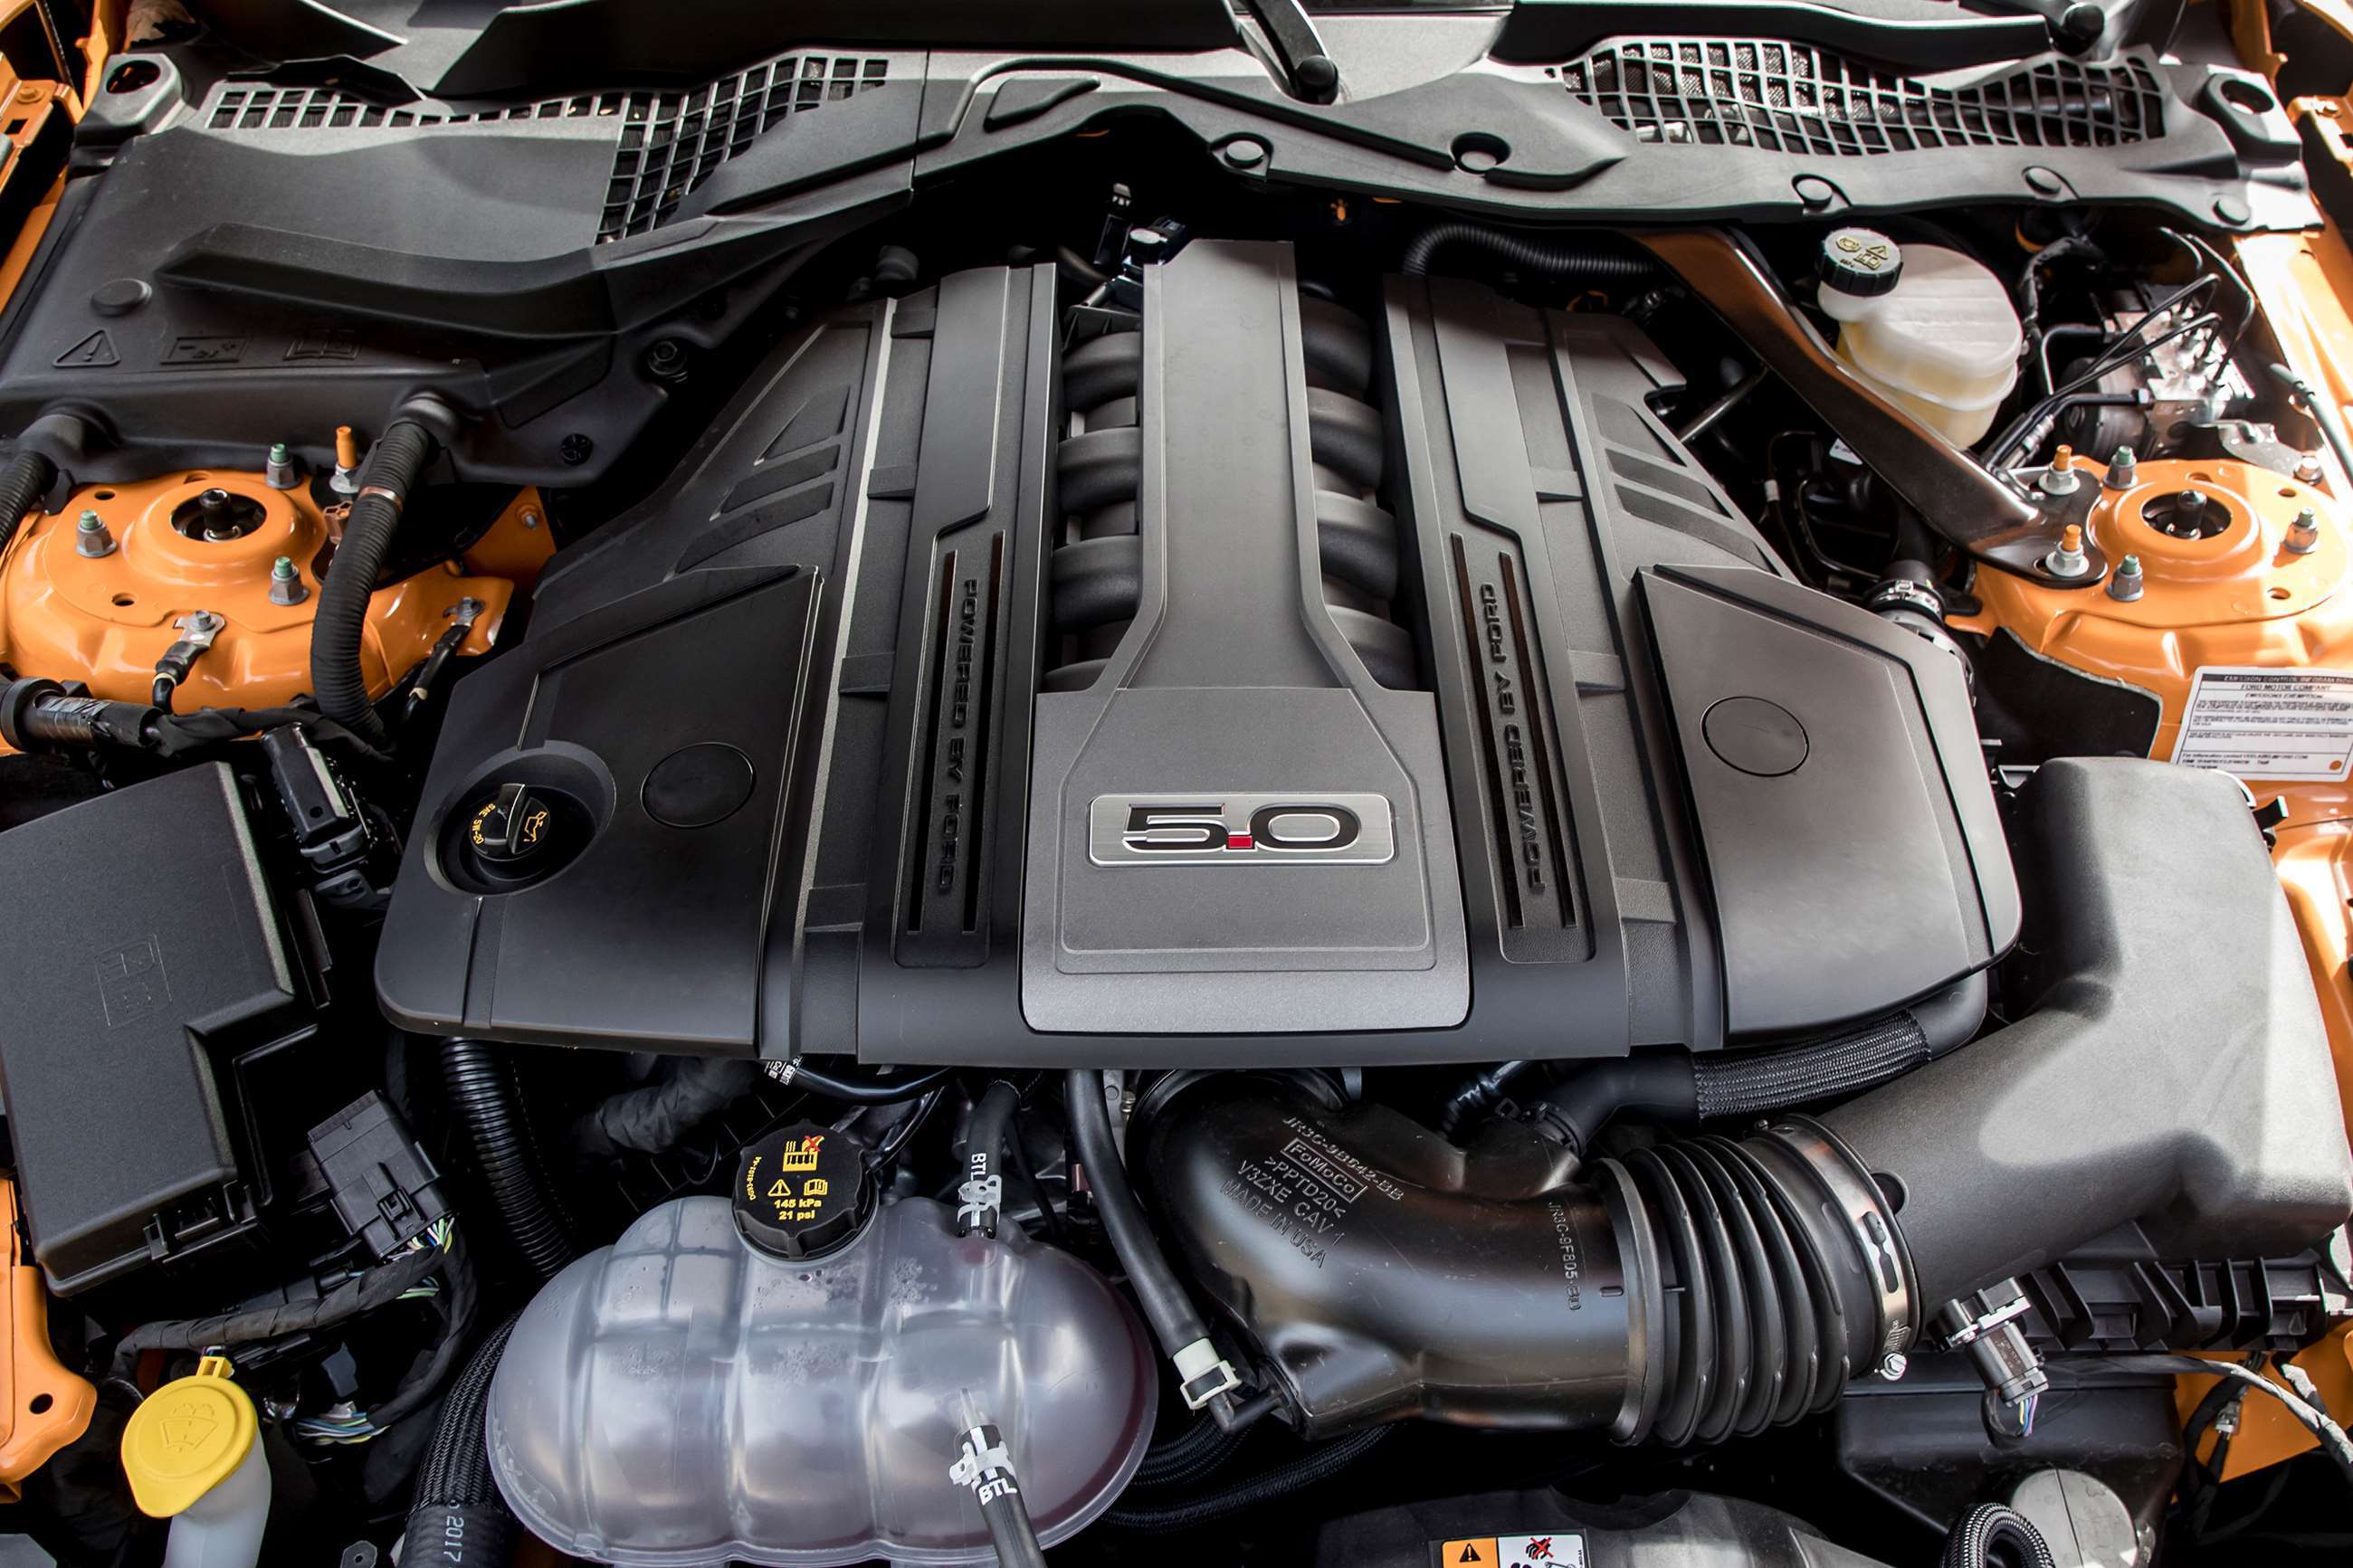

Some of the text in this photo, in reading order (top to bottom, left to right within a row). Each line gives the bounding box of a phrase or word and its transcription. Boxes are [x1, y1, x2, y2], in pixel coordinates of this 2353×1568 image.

[938, 579, 978, 889] POWERED BY FORD
[1480, 582, 1545, 893] POWERED BY FORD
[1122, 803, 1362, 853] 5.0
[971, 1153, 986, 1182] BTL
[1263, 1156, 1347, 1219] >PPTD20<
[1290, 1144, 1355, 1194] FoMoCo
[774, 1198, 822, 1209] 145 kPa
[778, 1210, 815, 1221] 21 psi
[1237, 1159, 1292, 1203] V3ZXE
[1294, 1202, 1334, 1234] CAV
[1220, 1178, 1327, 1269] MADE IN USA
[978, 1478, 1017, 1506] BTL
[443, 1515, 464, 1563] 2017
